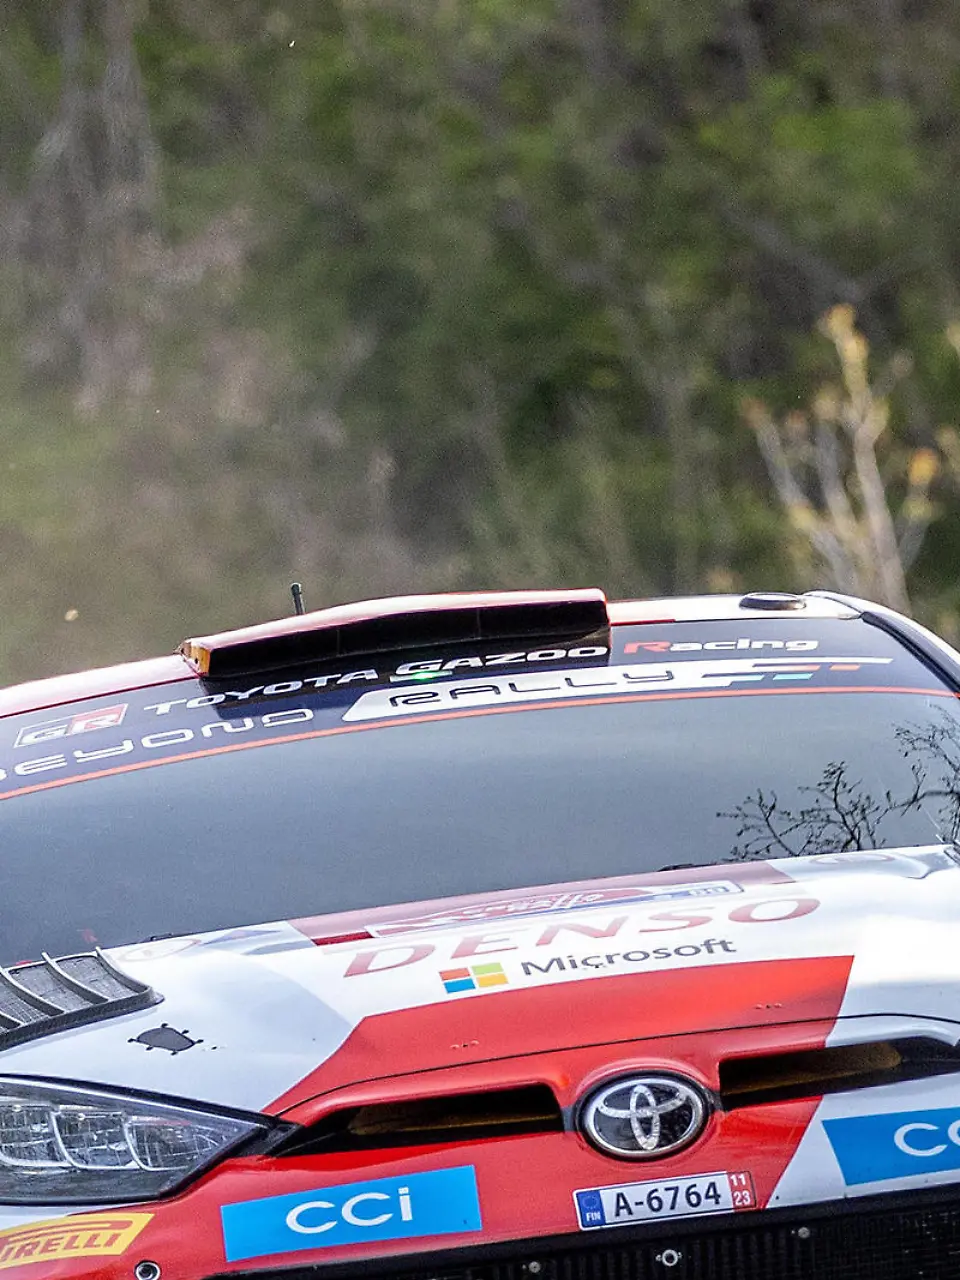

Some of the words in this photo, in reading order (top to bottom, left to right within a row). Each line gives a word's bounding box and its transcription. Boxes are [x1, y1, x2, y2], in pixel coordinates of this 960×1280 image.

[143, 668, 380, 715] TOYOTA
[396, 645, 608, 676] GAZOO
[623, 638, 819, 654] Racing
[0, 708, 314, 781] EYOND
[390, 670, 676, 707] RALLY
[19, 705, 123, 745] GR
[343, 897, 821, 978] DENSO
[521, 937, 737, 976] Microsoft
[614, 1181, 722, 1217] A-6764
[730, 1173, 746, 1187] 11
[733, 1190, 751, 1206] 23
[586, 1211, 601, 1222] FIN
